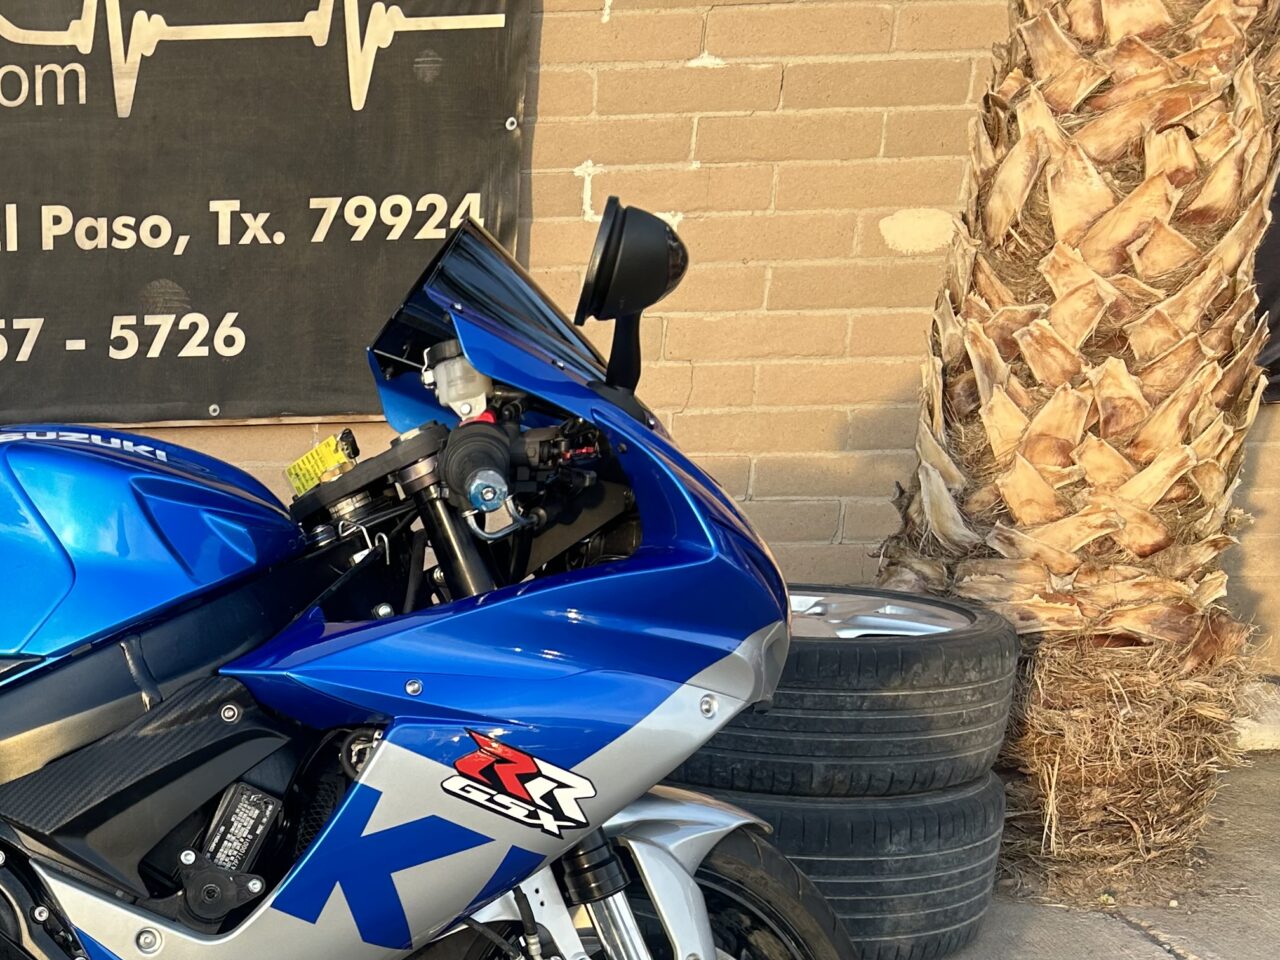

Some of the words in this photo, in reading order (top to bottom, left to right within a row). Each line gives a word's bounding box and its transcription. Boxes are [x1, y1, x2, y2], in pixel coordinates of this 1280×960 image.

[41, 204, 191, 256] Paso,
[209, 199, 286, 246] Tx.
[309, 192, 485, 243] 79924
[108, 311, 246, 360] 5726
